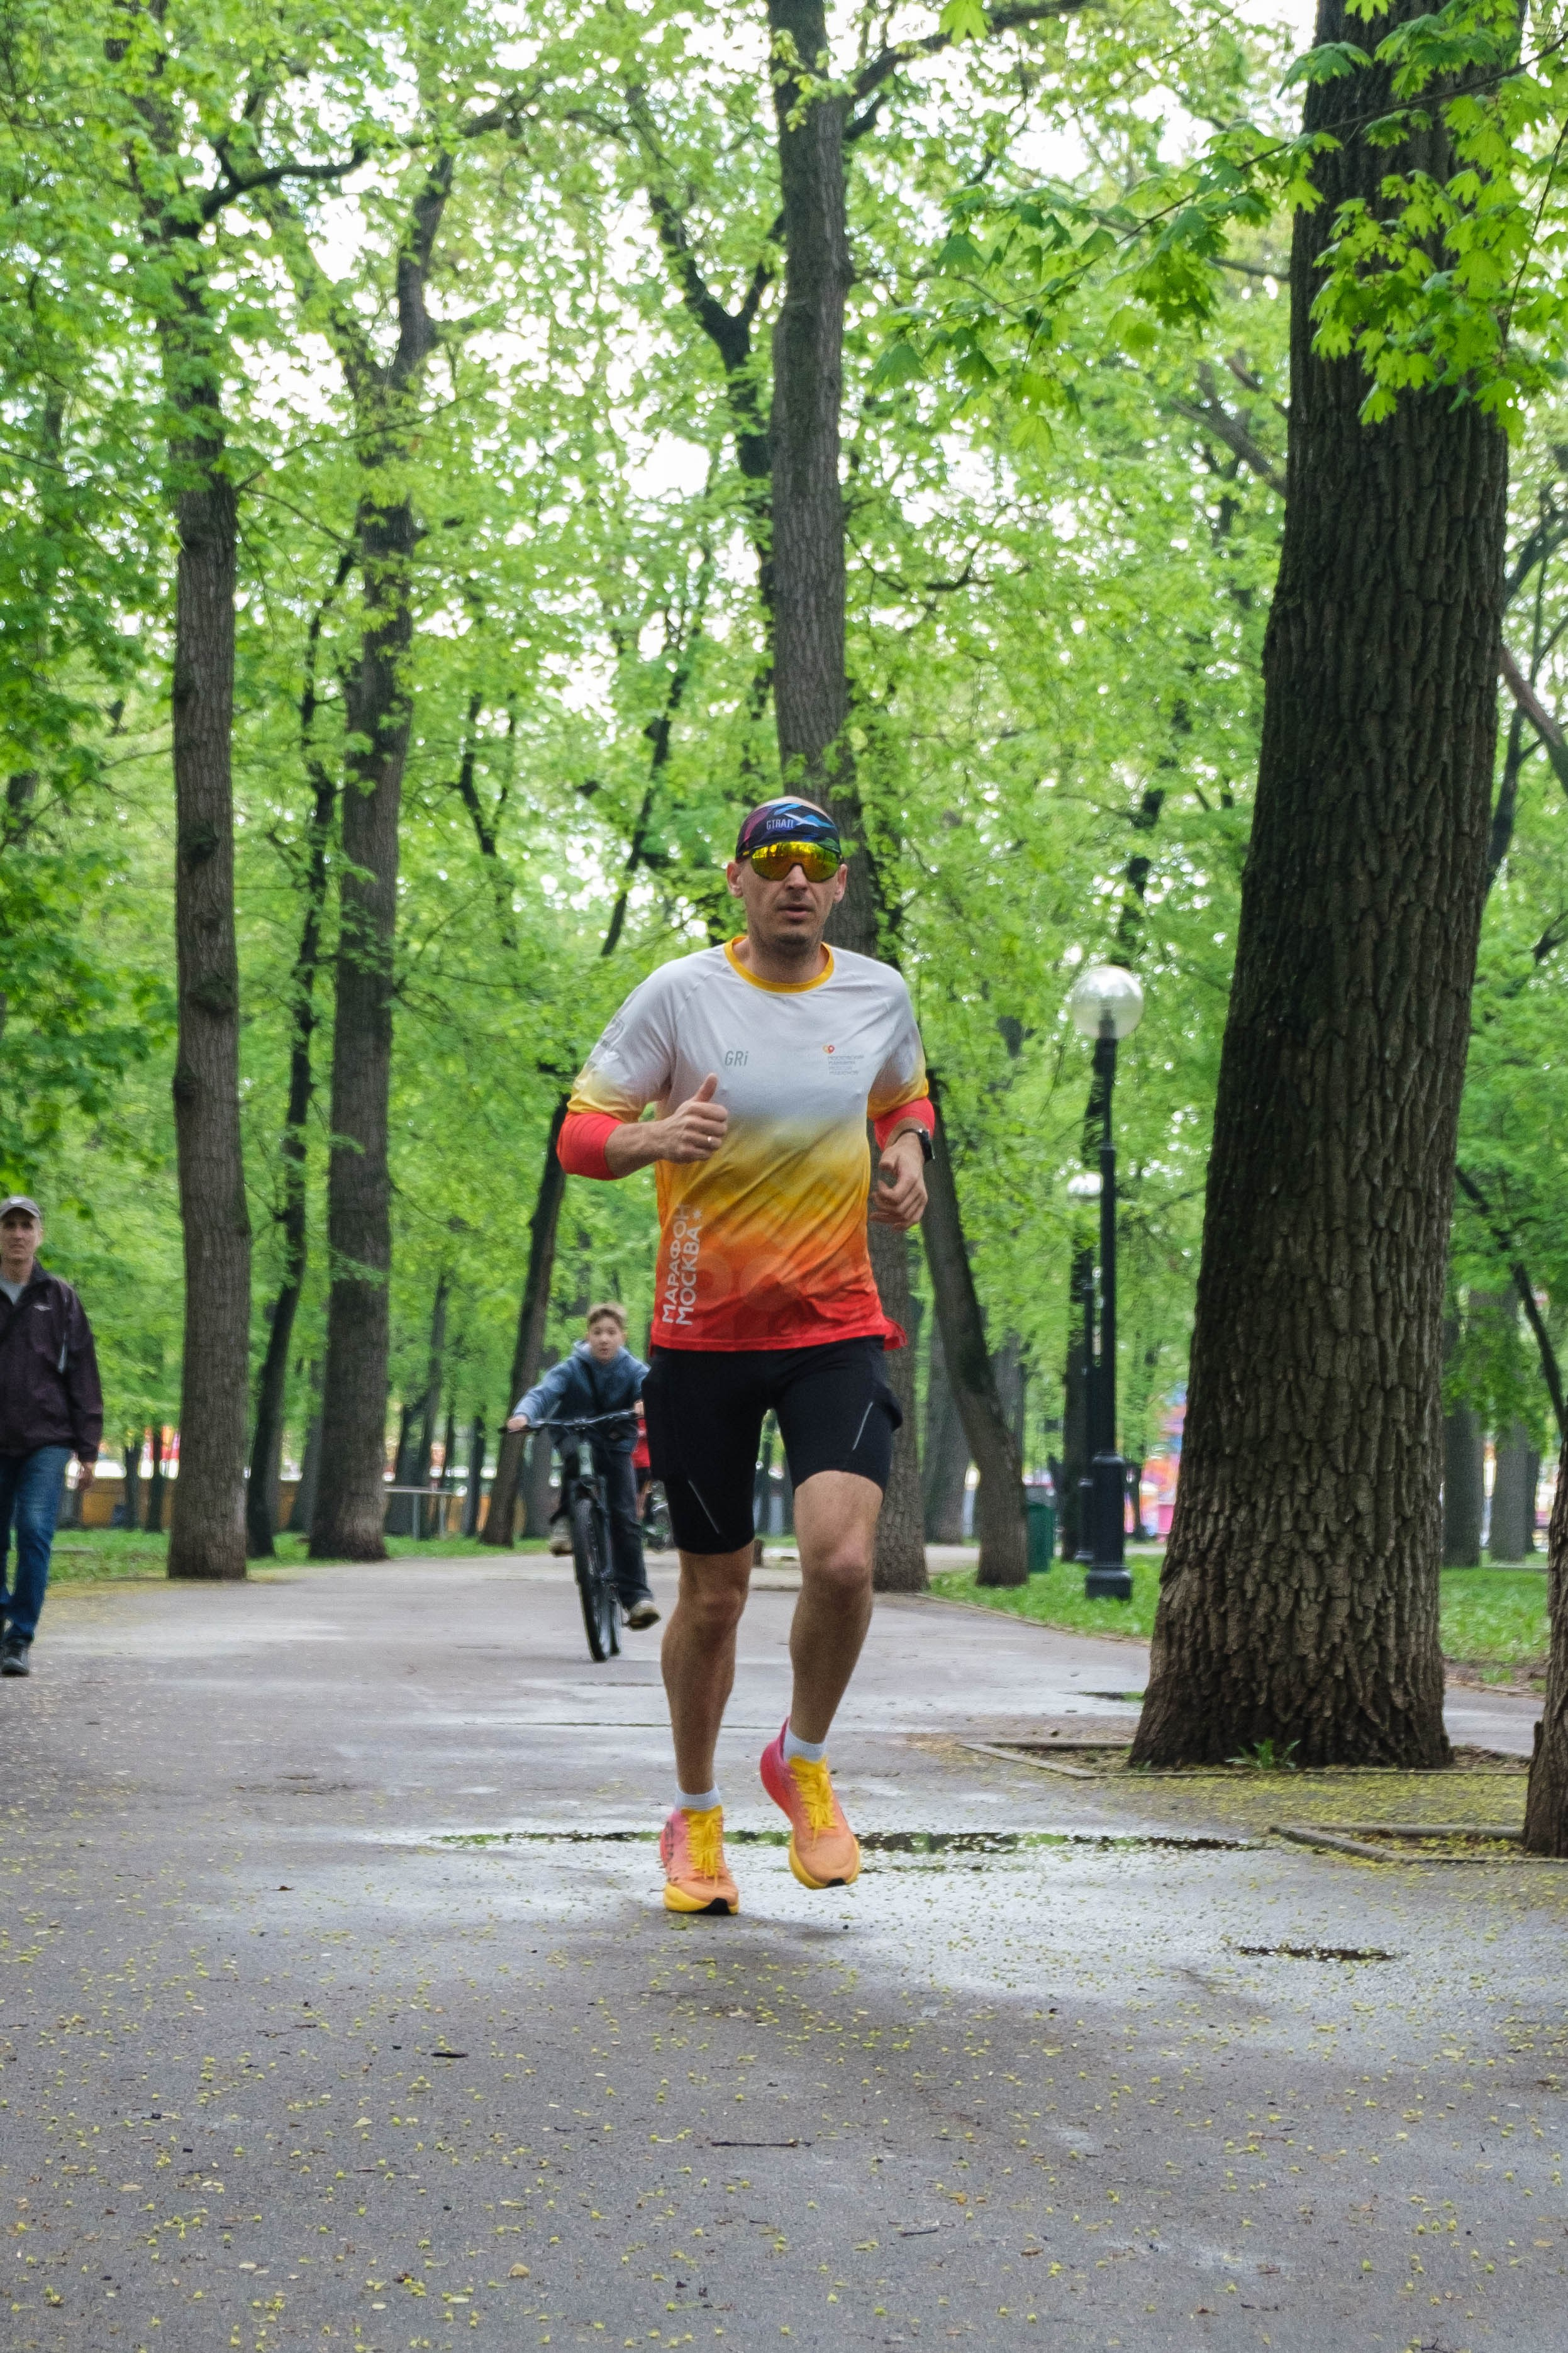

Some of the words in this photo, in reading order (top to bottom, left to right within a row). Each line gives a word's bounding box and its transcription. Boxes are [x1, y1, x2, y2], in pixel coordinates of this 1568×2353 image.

[725, 1050, 748, 1066] GRi
[662, 1203, 689, 1324] МАРАФОН
[676, 1226, 702, 1326] МОСКВА
